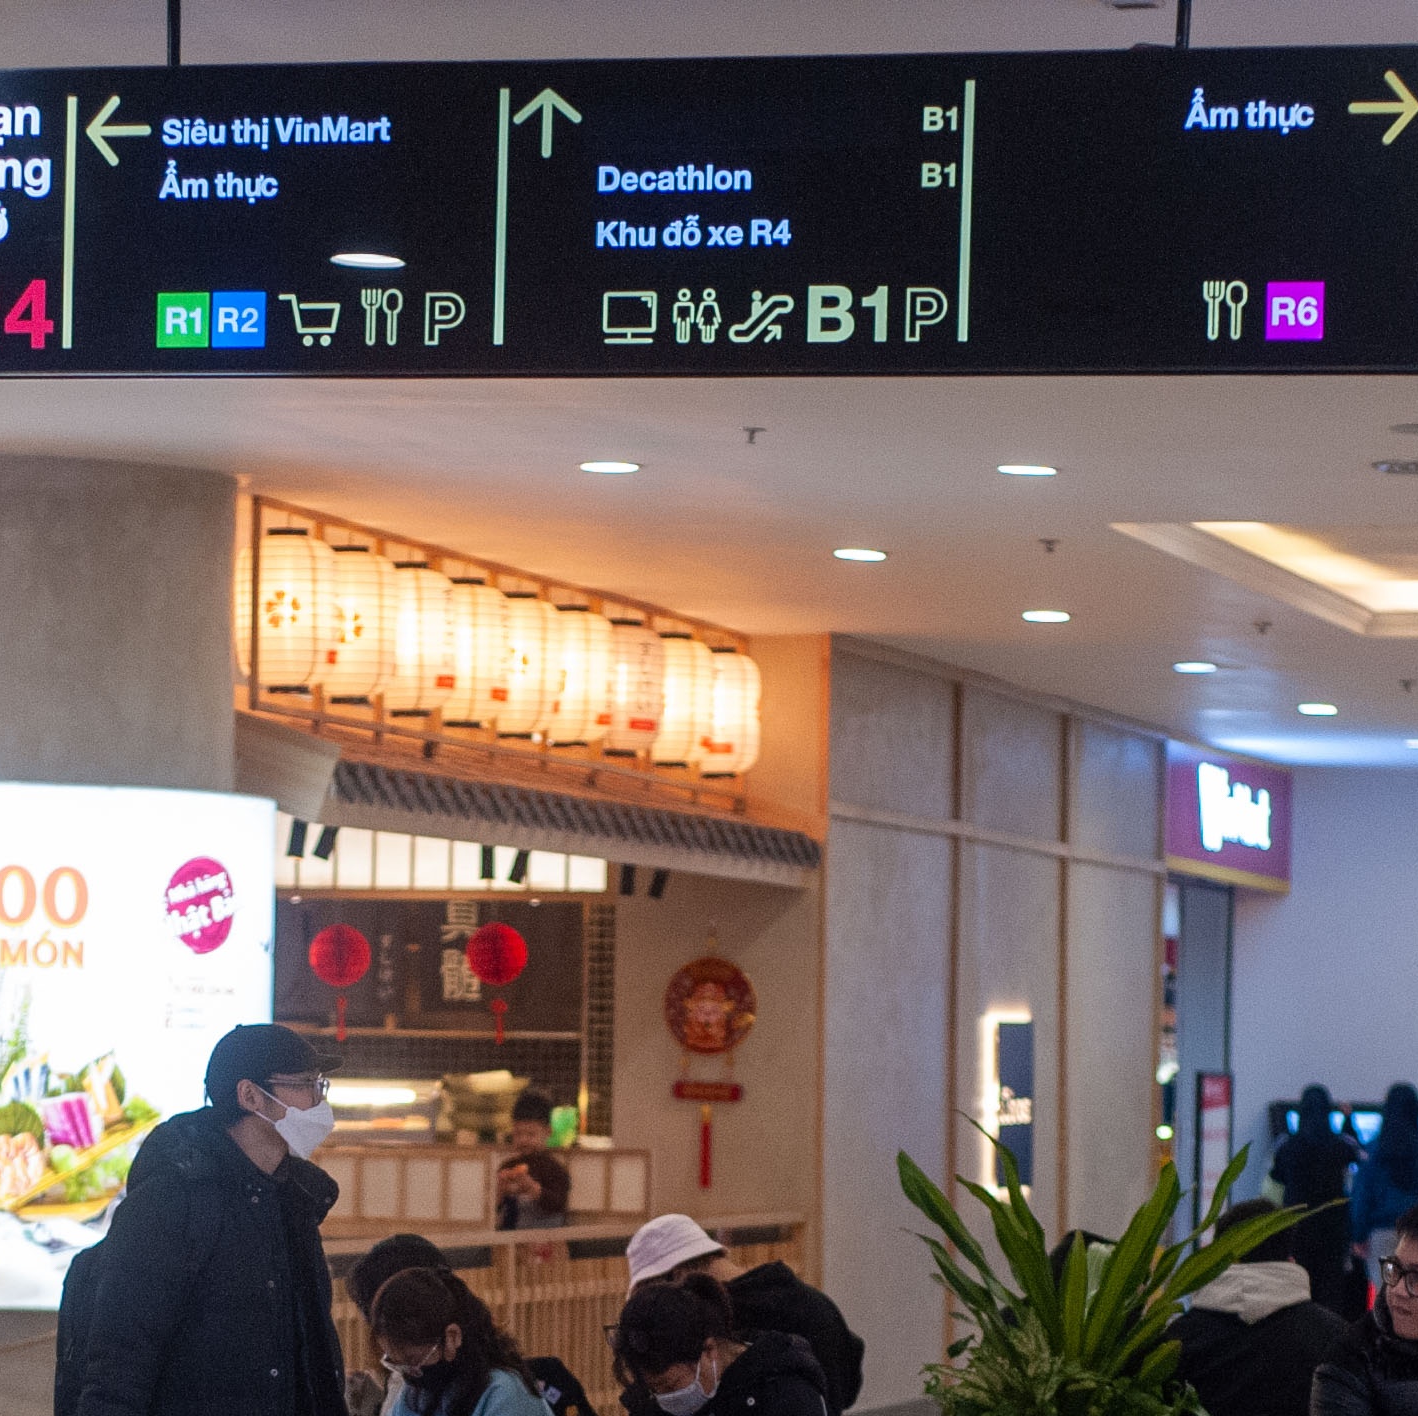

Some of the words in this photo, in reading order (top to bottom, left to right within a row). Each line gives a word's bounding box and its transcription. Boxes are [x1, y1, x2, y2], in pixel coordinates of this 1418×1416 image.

[923, 106, 958, 132] B1
[1183, 86, 1239, 130] Ẩm
[1243, 98, 1315, 134] thực
[161, 117, 227, 147] Siêu
[231, 117, 270, 151] thị
[273, 116, 392, 145] VinMart
[158, 159, 210, 200] Ẩm
[213, 171, 279, 204] thực
[597, 164, 753, 193] Decathlon
[921, 162, 957, 188] B1
[595, 220, 657, 249] Khu
[661, 214, 702, 248] đỗ
[706, 224, 744, 248] xe
[749, 218, 792, 247] R4
[165, 306, 202, 335] R1
[217, 306, 259, 333] R2
[806, 284, 889, 343] B1
[1270, 296, 1322, 327] R6
